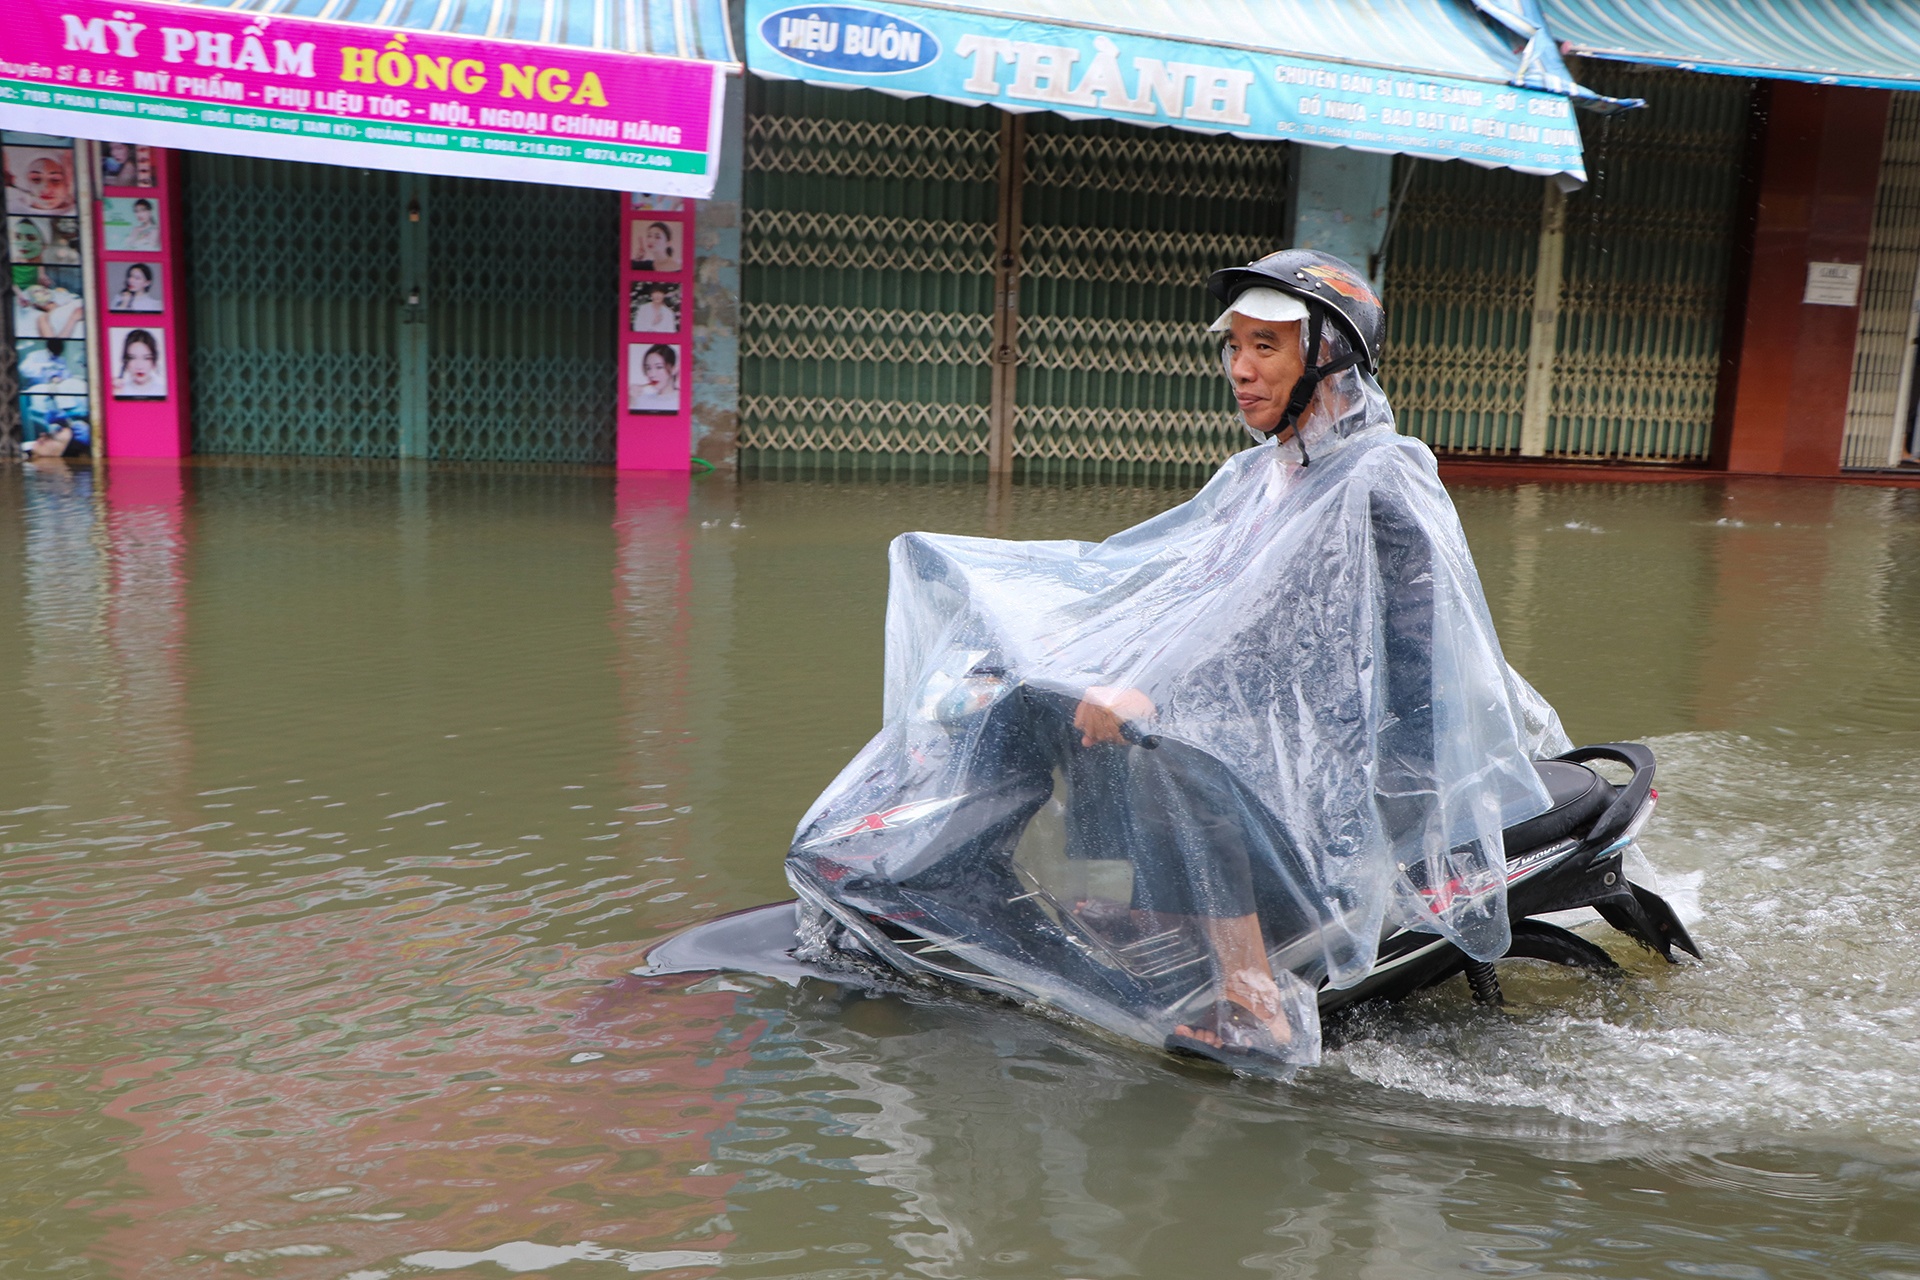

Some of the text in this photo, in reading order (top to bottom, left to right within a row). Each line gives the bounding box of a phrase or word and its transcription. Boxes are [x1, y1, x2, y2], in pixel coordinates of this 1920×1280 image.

[60, 10, 609, 107] MỸ PHẨM HỒNG NGA
[778, 13, 922, 62] HIỆU BUÔN
[77, 68, 93, 83] &
[133, 70, 171, 92] MỸ
[175, 73, 244, 101] PHẨM
[264, 85, 311, 111] PHỤ
[314, 89, 364, 115] LIỆU
[367, 94, 411, 118] TÓC
[429, 100, 476, 126] NỘI,
[479, 107, 548, 134] NGOẠI
[551, 113, 619, 138] CHÍNH
[953, 35, 1255, 127] THÀNH
[1274, 65, 1338, 89] CHUYÊN
[1340, 71, 1373, 94] BÁN
[1381, 108, 1413, 127] BAO
[1416, 111, 1447, 133] BẠT
